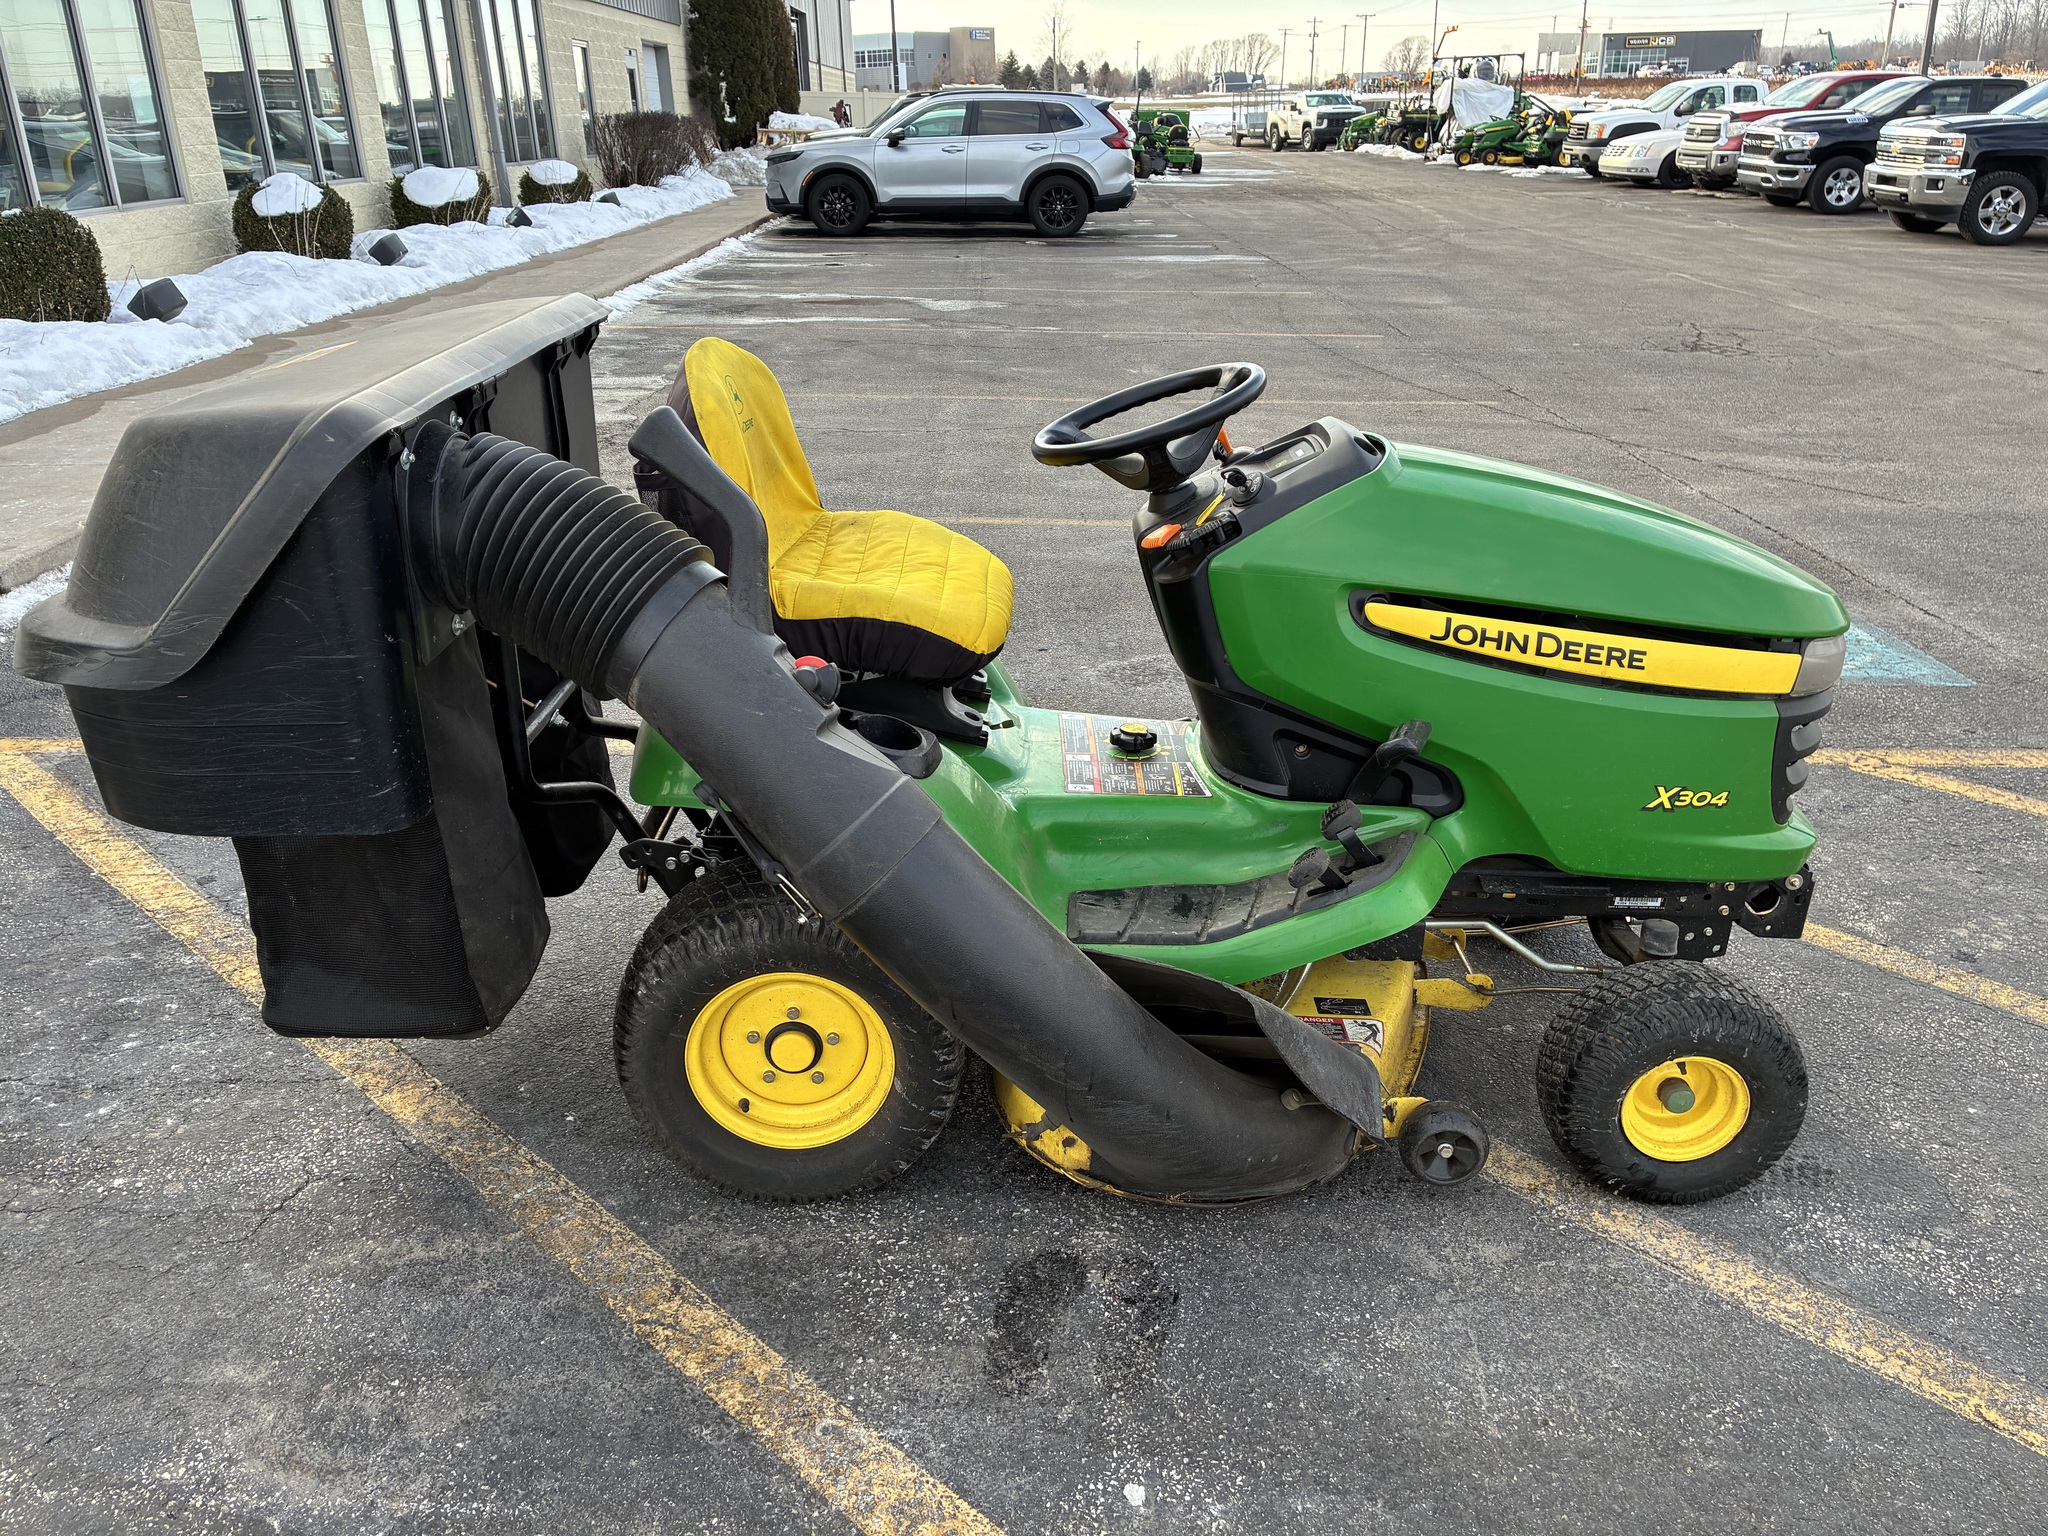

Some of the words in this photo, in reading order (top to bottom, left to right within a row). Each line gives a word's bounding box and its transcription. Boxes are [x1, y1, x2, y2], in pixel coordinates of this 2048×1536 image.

[1651, 36, 1675, 47] JCB
[1429, 616, 1530, 656] JOHN
[1534, 631, 1648, 671] DEERE
[1641, 785, 1730, 812] X304
